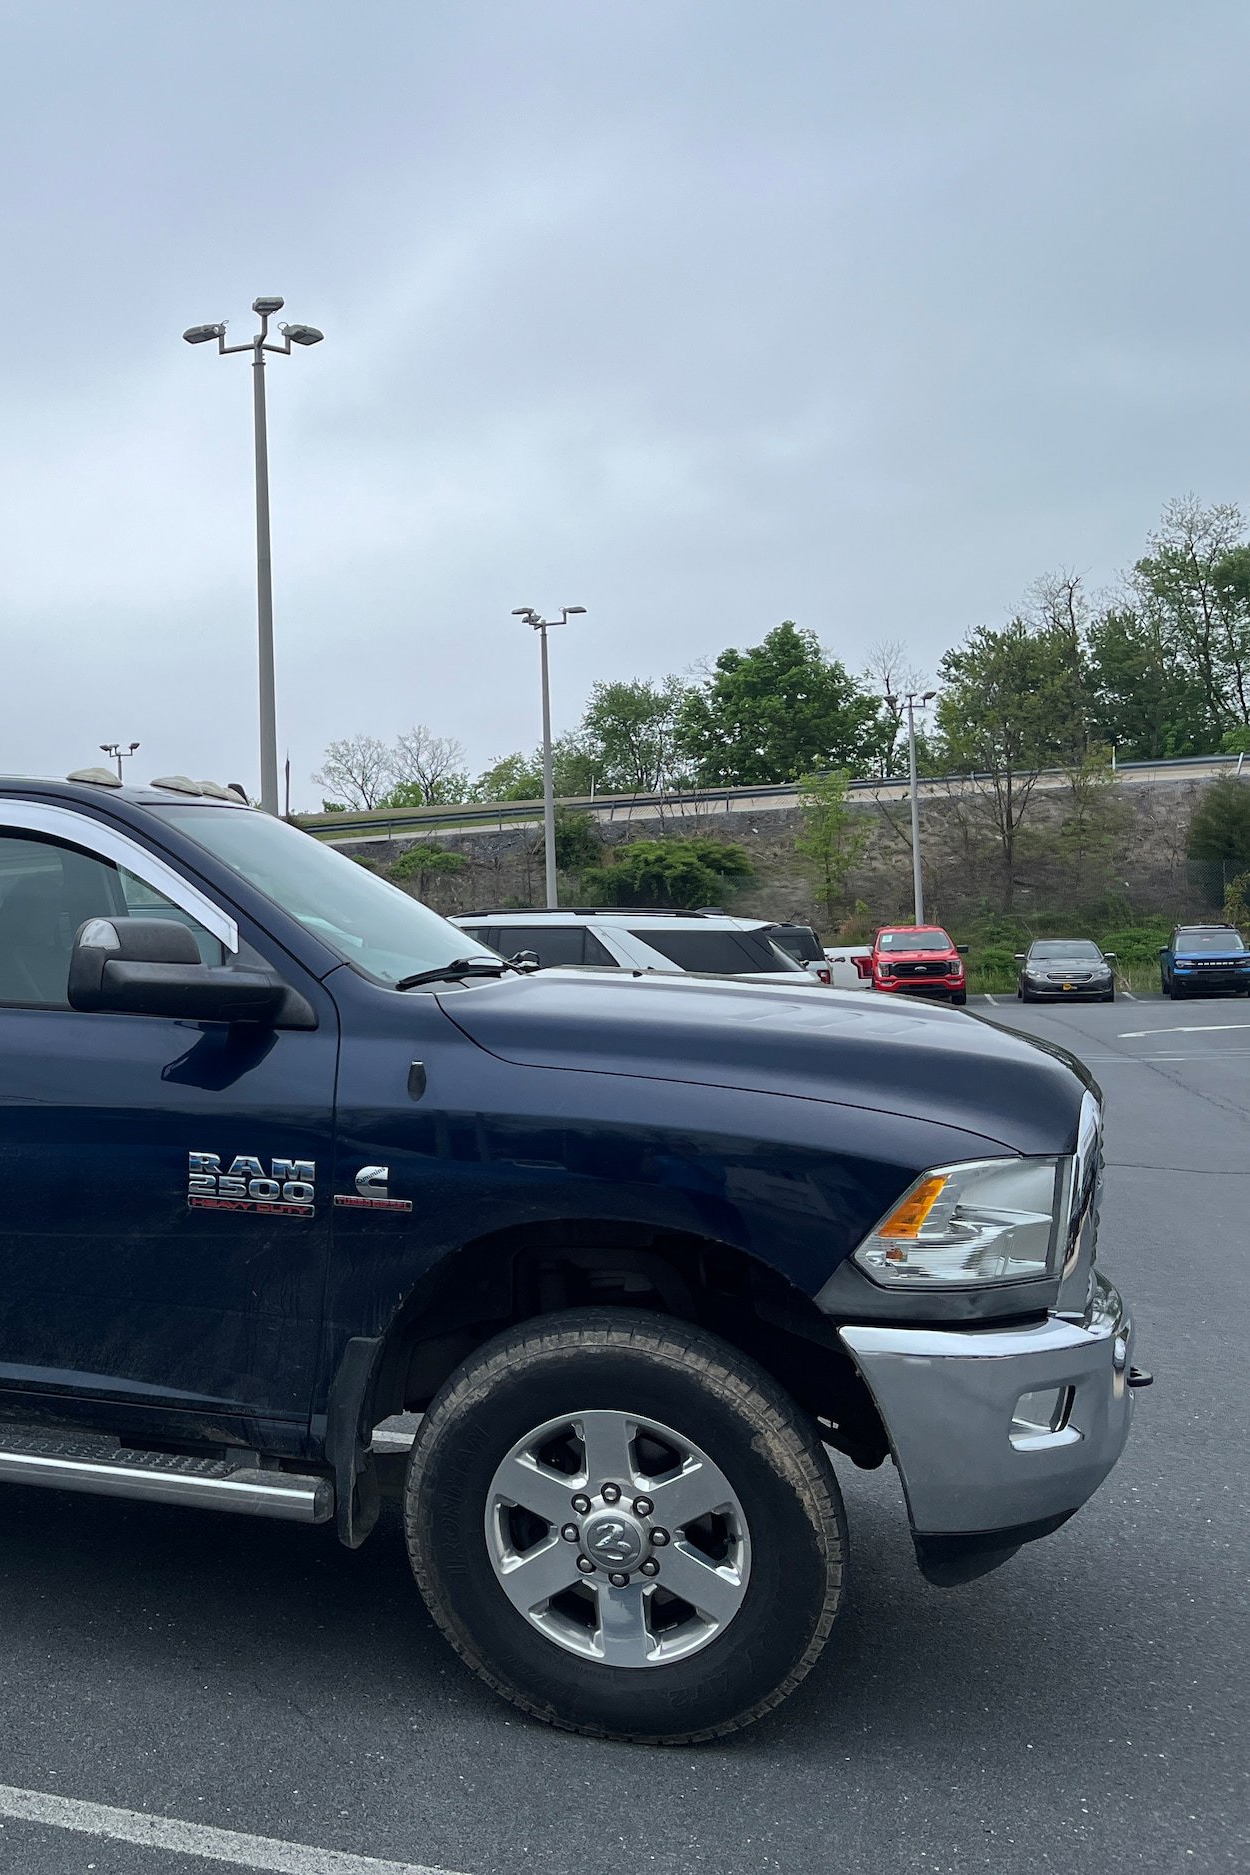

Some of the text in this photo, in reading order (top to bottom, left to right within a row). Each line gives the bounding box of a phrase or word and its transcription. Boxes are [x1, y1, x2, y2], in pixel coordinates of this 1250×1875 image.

[188, 1151, 316, 1182] RAM
[356, 1166, 387, 1184] Cummins
[188, 1173, 315, 1204] 2500
[191, 1197, 310, 1215] HEAVY DUTY
